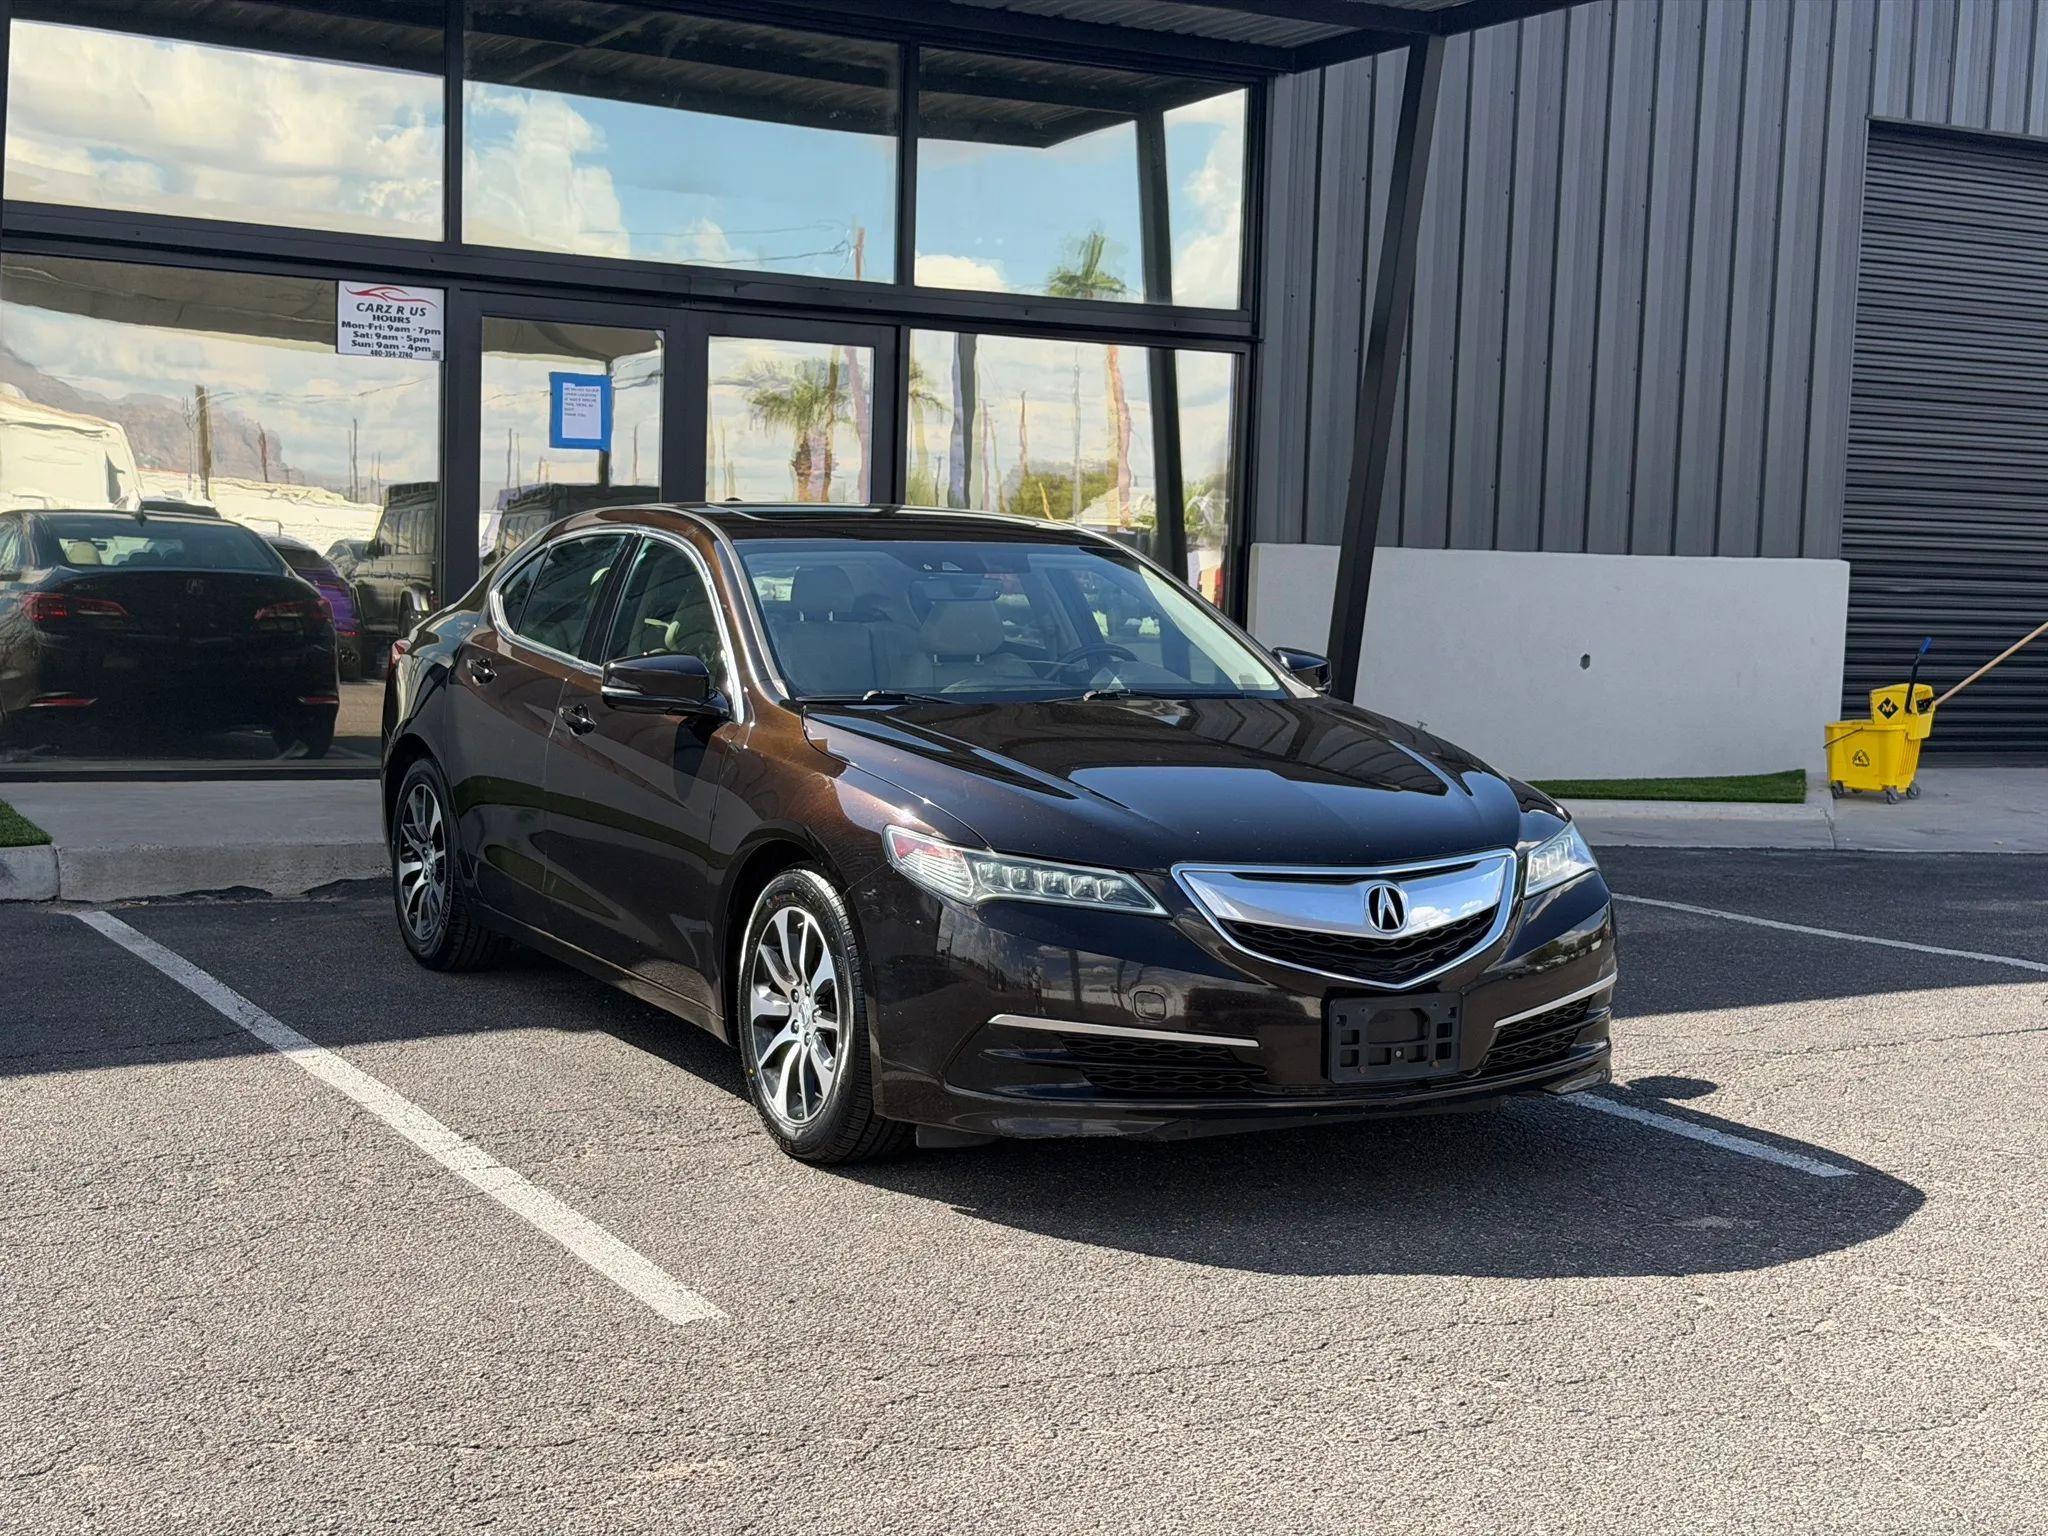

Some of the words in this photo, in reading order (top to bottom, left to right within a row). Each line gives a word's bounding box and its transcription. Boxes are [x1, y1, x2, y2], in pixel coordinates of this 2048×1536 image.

[356, 303, 392, 314] CARZ
[396, 306, 405, 315] R
[409, 307, 427, 317] US
[372, 314, 411, 324] HOURS
[341, 321, 385, 331] Mon-Fri:
[387, 324, 410, 333] 9am
[418, 327, 441, 336] 7pm
[353, 331, 373, 339] Sat:
[375, 333, 398, 341] 9am
[406, 335, 430, 344] 5pm
[352, 340, 374, 348] Sun:
[376, 342, 399, 350] 9am
[407, 344, 431, 353] 4pm
